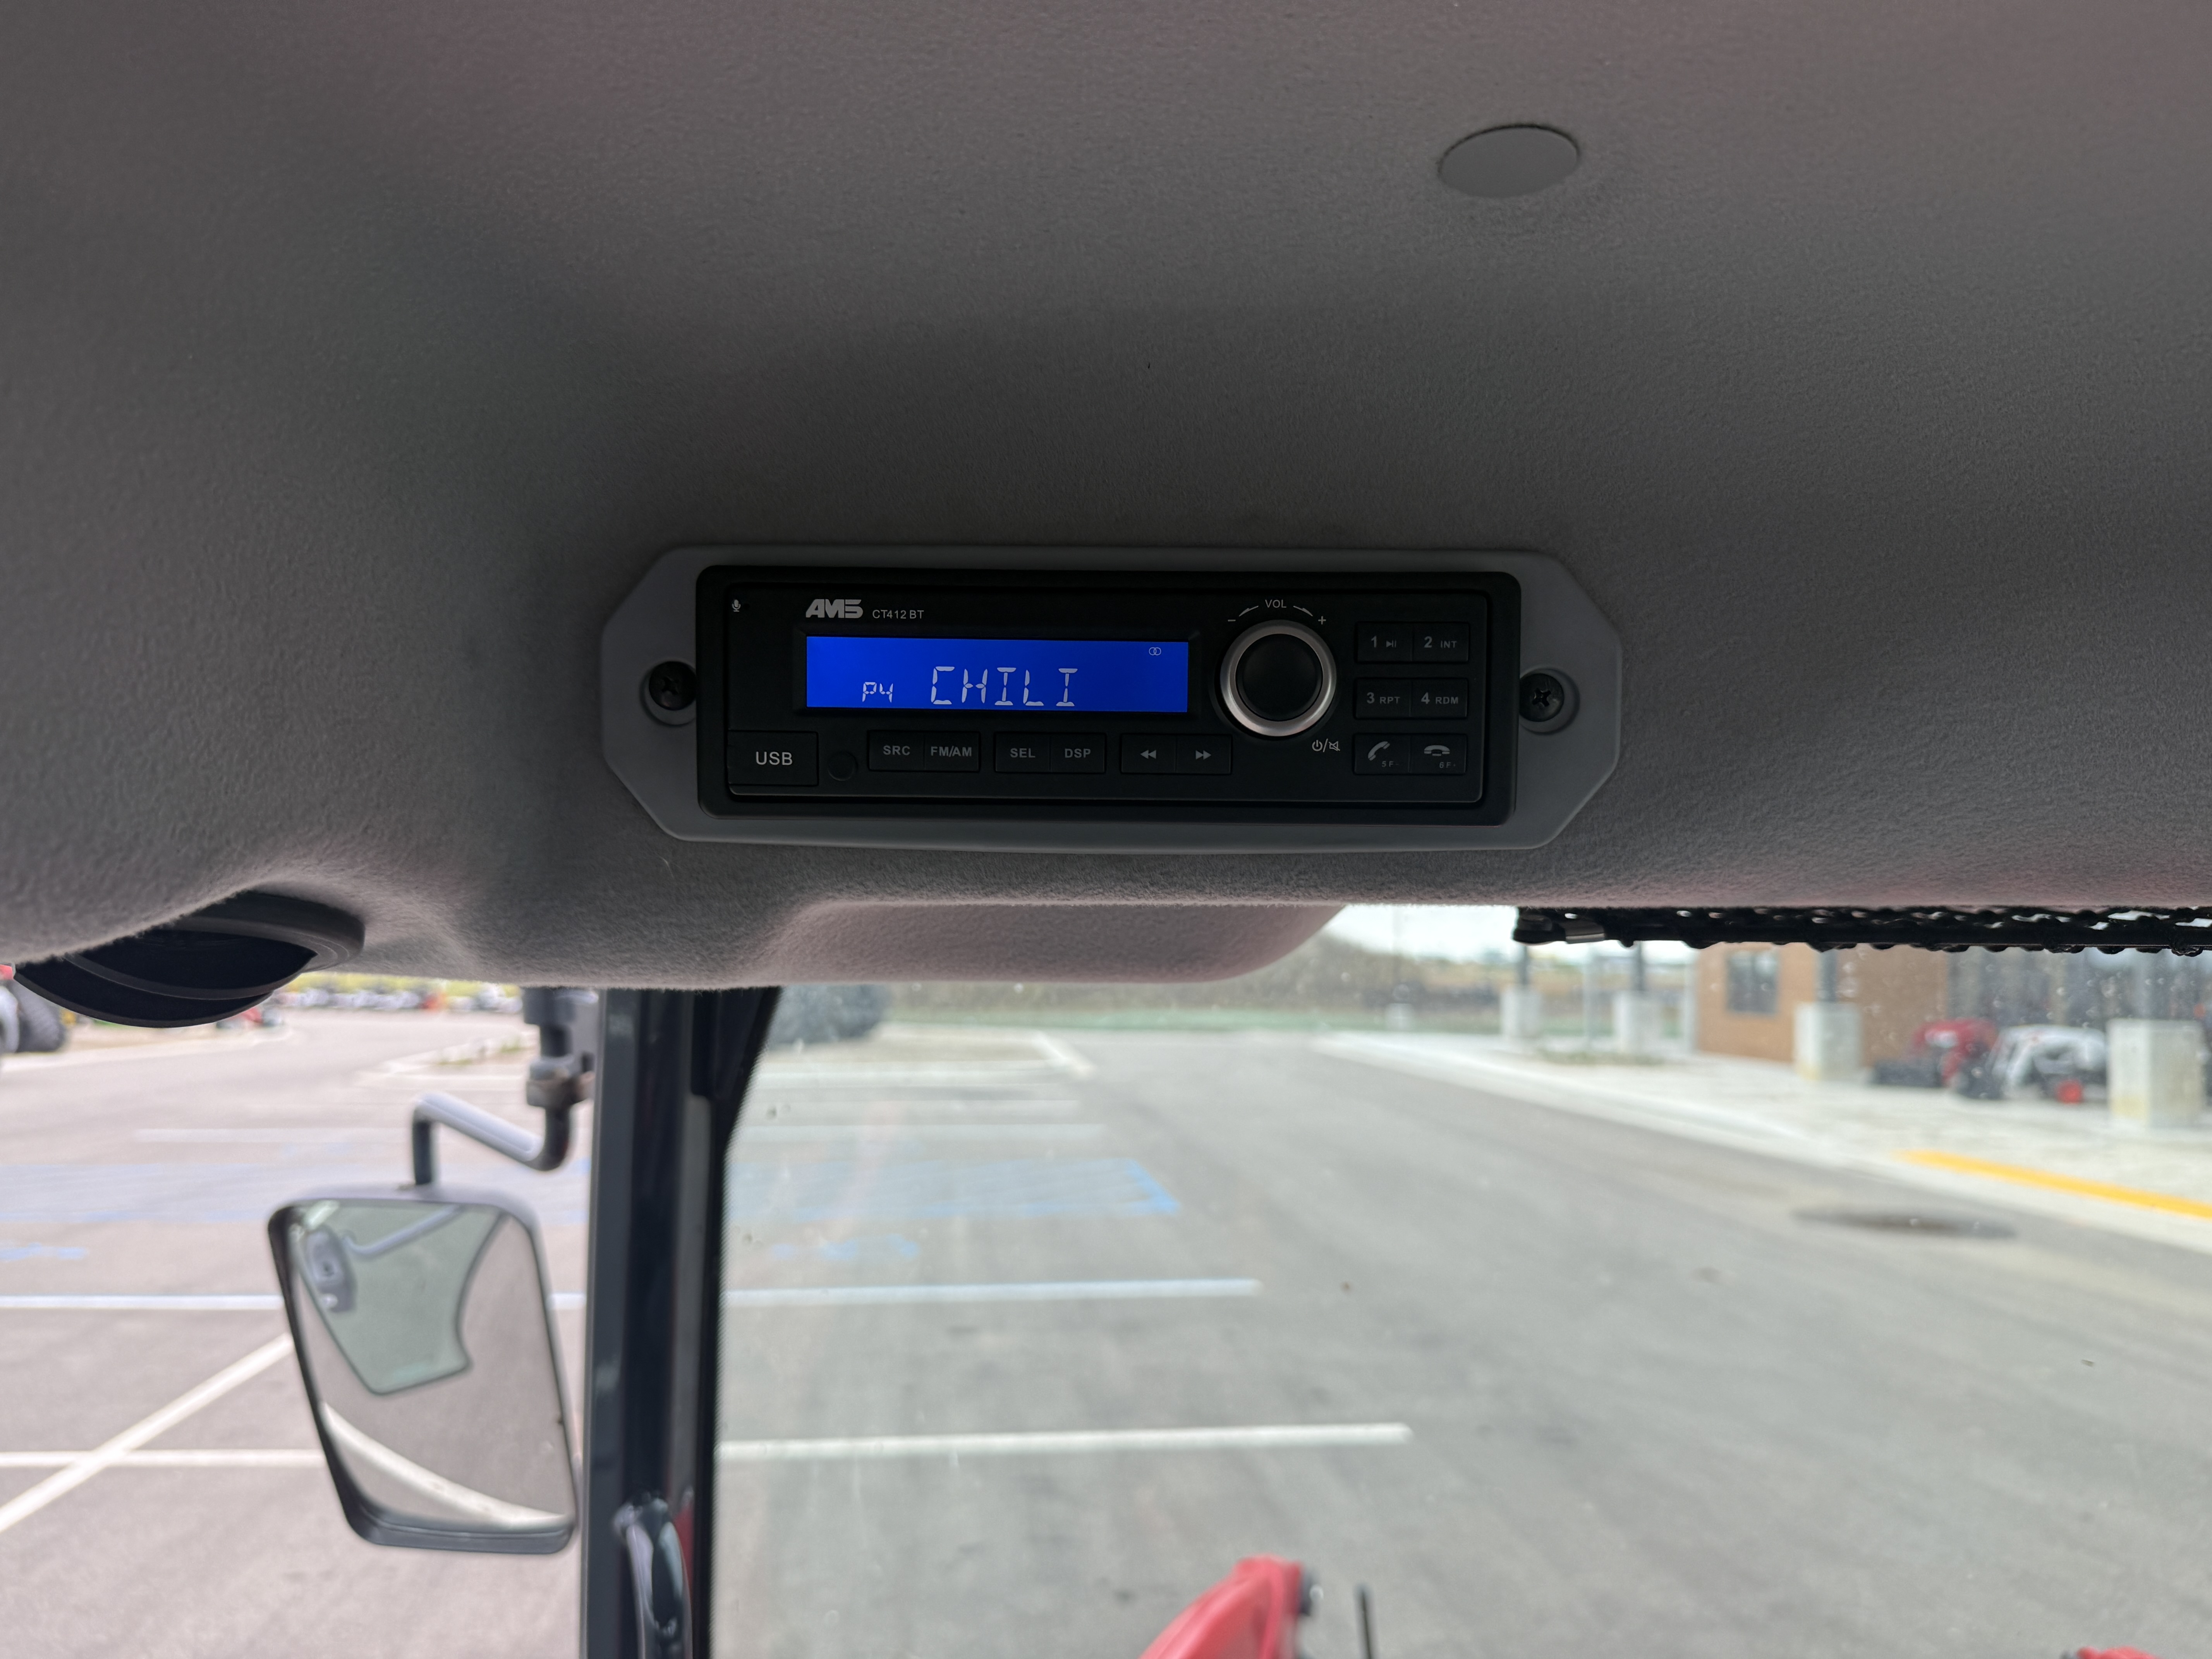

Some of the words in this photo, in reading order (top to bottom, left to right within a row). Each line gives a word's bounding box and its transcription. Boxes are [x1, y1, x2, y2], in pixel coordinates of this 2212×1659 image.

[805, 599, 864, 618] AMS
[1265, 599, 1287, 608] VOL
[872, 610, 907, 619] CT412
[909, 610, 924, 619] BT
[1371, 635, 1377, 648] 1
[1424, 636, 1432, 648] 2
[931, 666, 1078, 707] CHILI
[1367, 692, 1375, 704] 3
[1421, 692, 1430, 704] 4
[883, 745, 910, 756] SRC
[931, 745, 972, 757] FM/AM
[1010, 748, 1036, 758] SEL
[1065, 748, 1091, 758] DSP
[756, 751, 793, 765] USB
